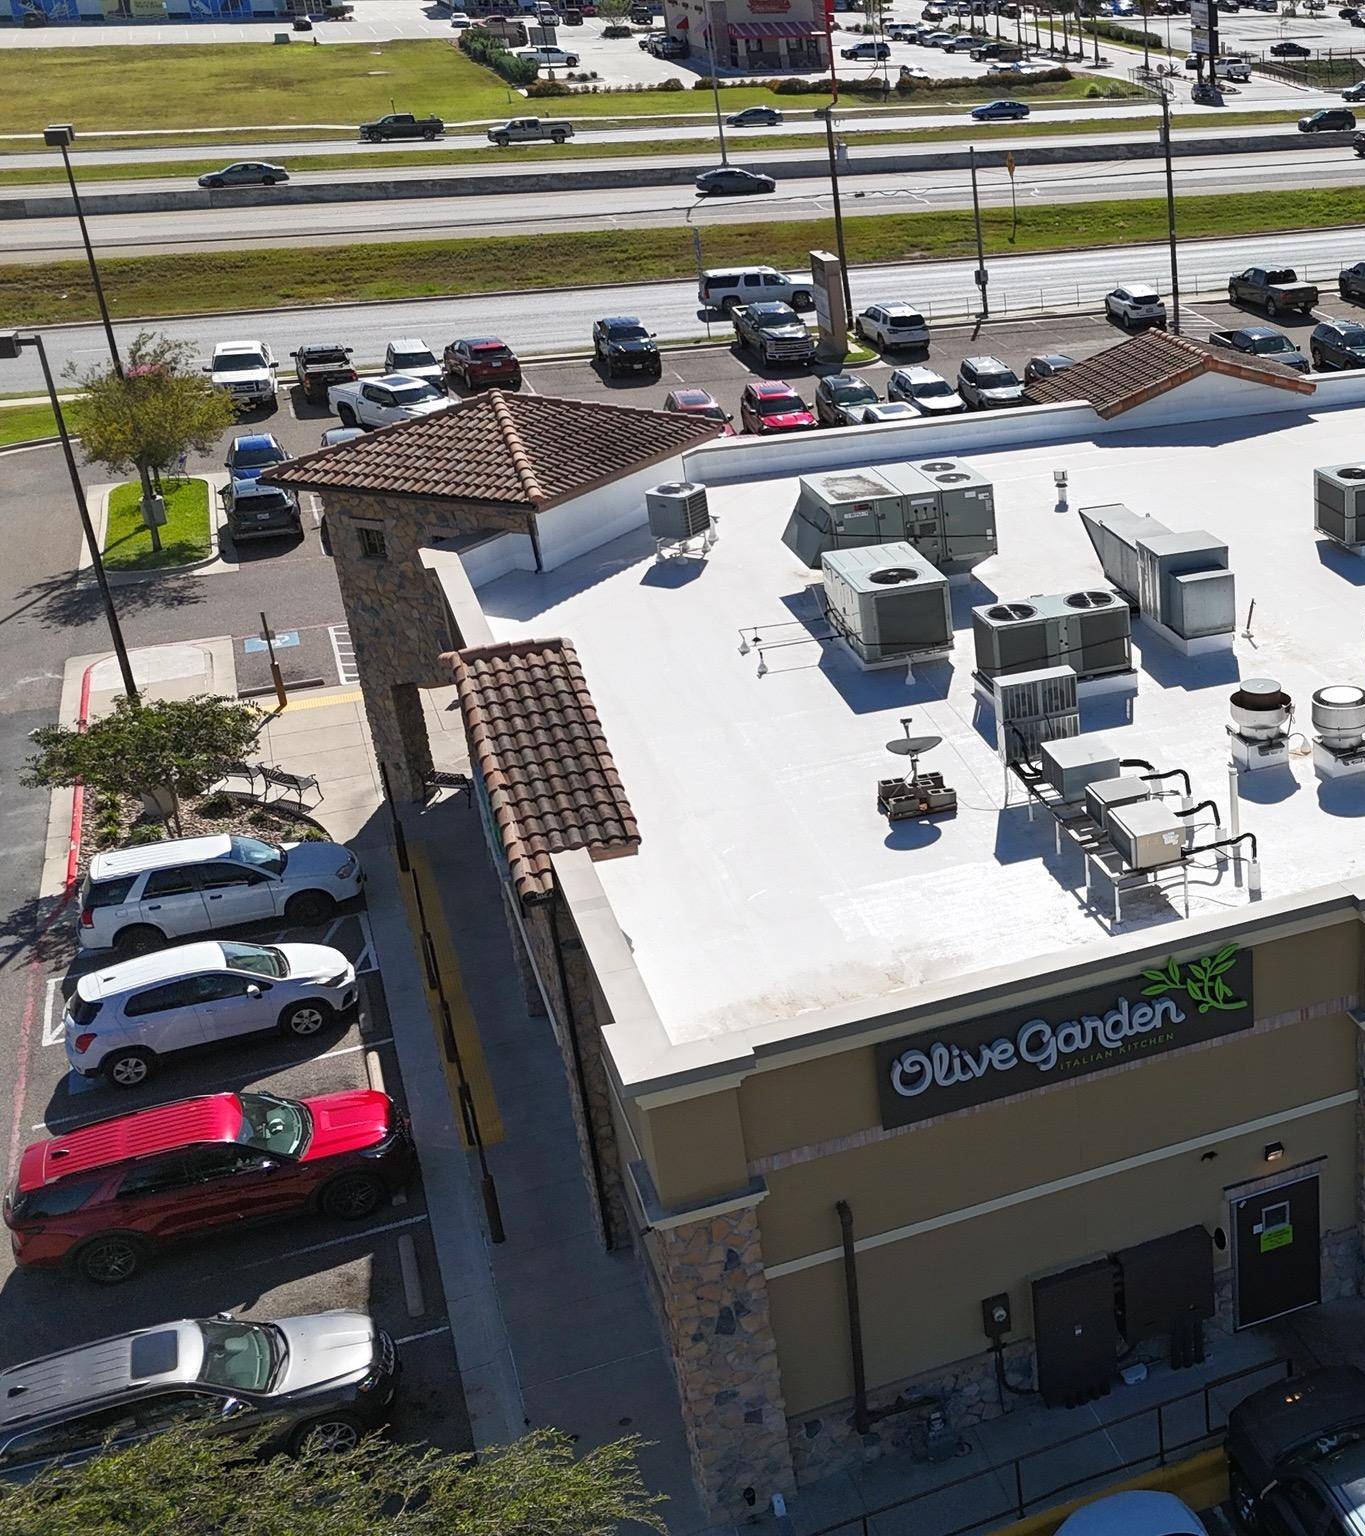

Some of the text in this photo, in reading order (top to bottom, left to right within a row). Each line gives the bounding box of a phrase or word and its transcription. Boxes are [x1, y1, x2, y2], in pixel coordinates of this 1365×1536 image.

[891, 996, 1186, 1097] Olive Garden
[1059, 1032, 1176, 1071] ITALIAN KITCHEN
